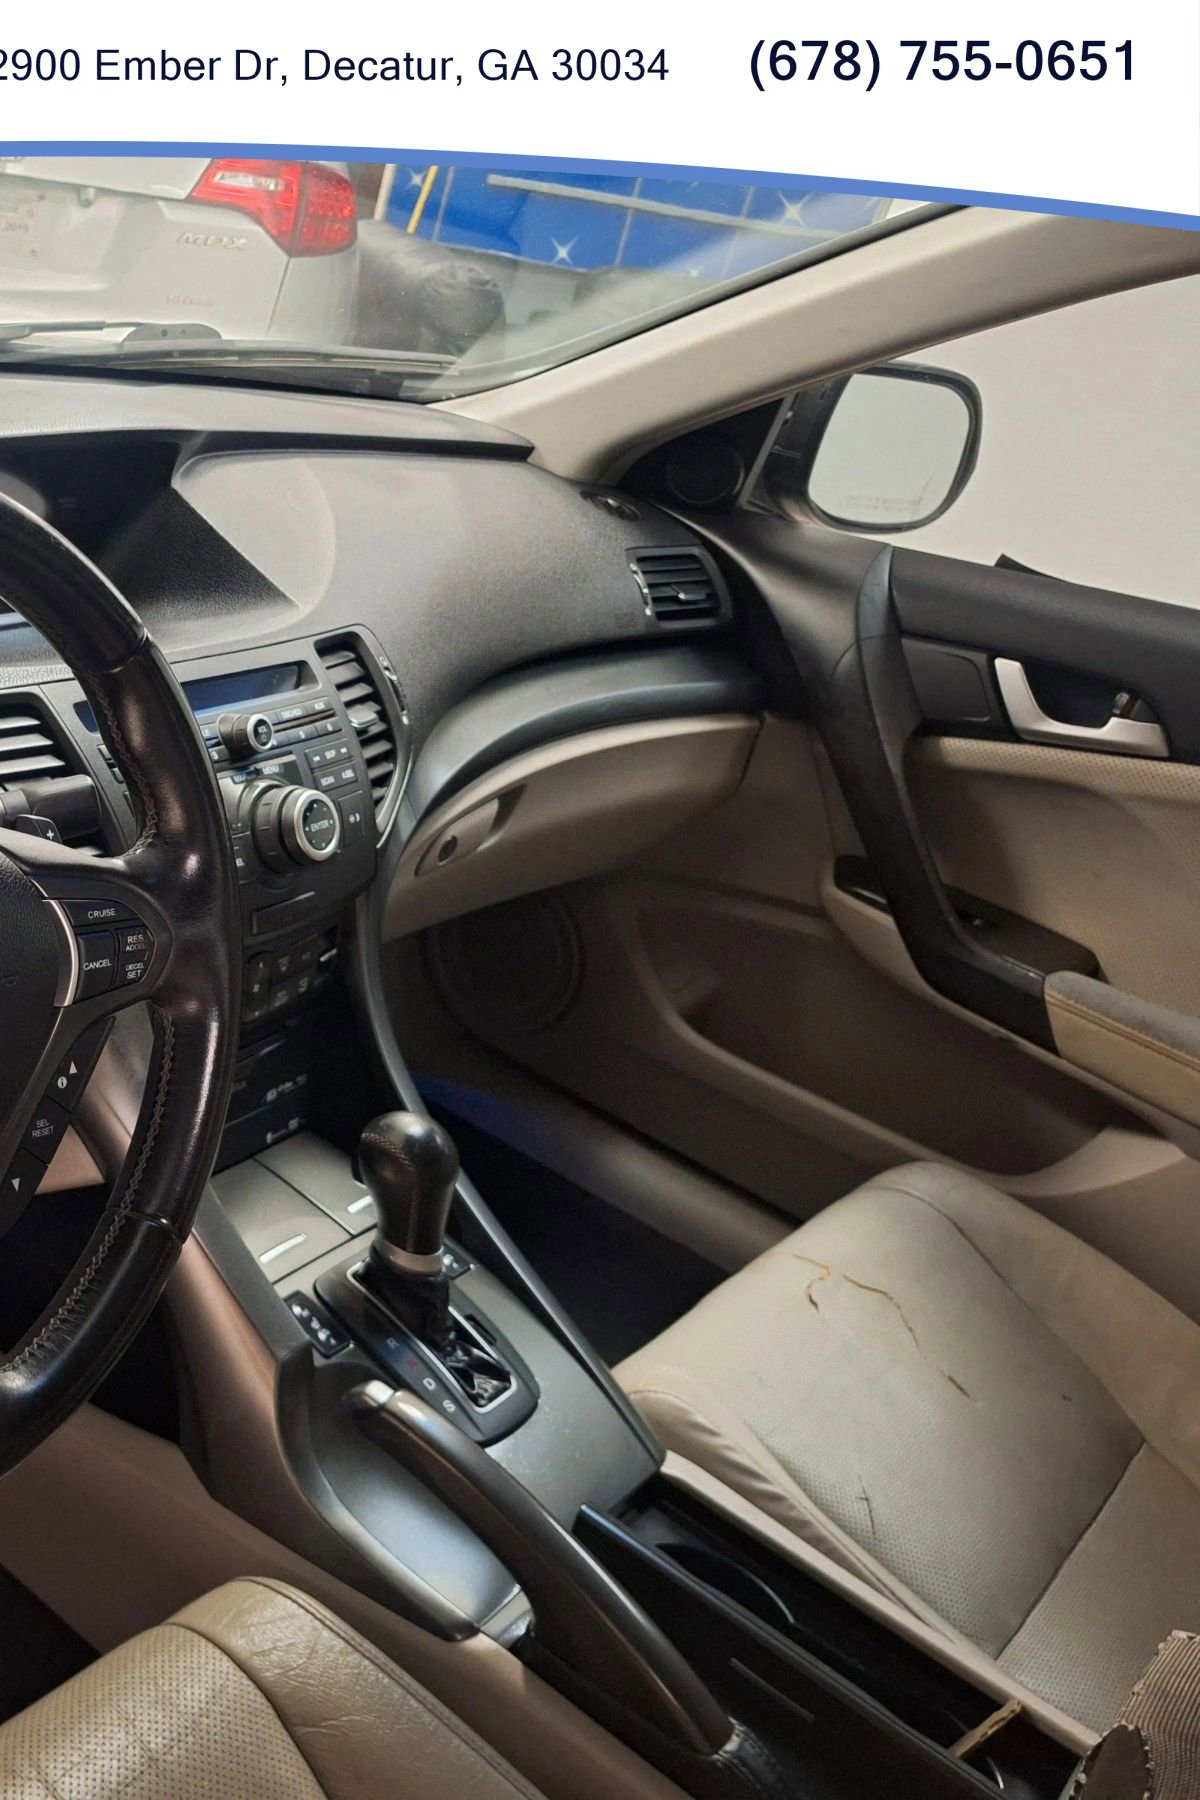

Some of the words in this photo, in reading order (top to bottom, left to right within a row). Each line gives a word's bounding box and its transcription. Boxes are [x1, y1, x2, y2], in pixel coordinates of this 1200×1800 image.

[311, 821, 329, 832] ENTER
[88, 908, 117, 919] CRUISE
[127, 935, 144, 944] RES
[126, 944, 145, 952] ACCEL
[83, 959, 112, 971] CANCEL
[126, 962, 144, 971] DECEL
[127, 970, 141, 979] SET
[36, 1119, 50, 1128] SEL
[32, 1126, 55, 1138] RESET
[386, 1337, 399, 1349] R
[423, 1378, 436, 1391] D
[442, 1400, 455, 1413] S
